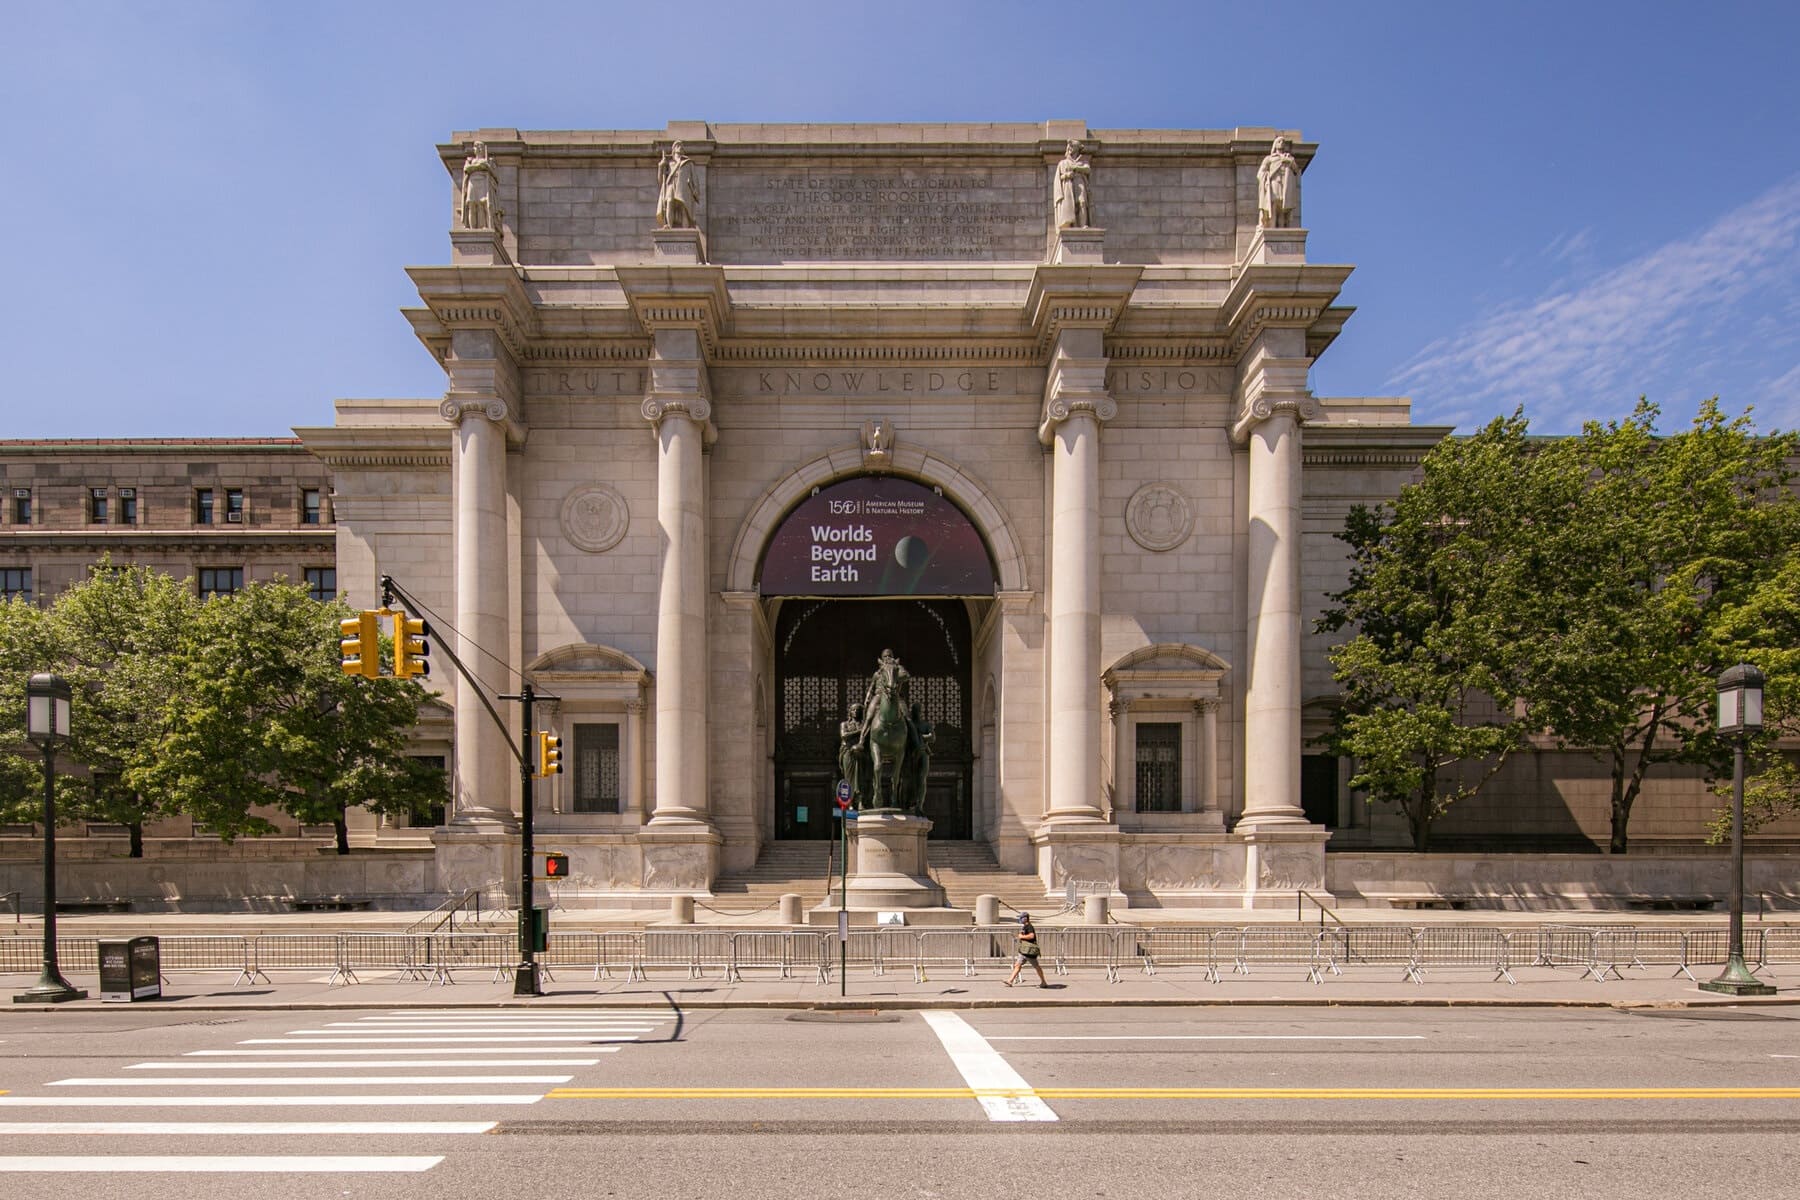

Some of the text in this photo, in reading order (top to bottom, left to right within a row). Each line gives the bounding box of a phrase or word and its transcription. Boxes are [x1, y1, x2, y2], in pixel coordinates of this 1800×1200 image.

[766, 179, 803, 189] STATE
[808, 179, 825, 189] OF
[862, 179, 894, 189] YORK
[793, 191, 961, 202] THEODORE ROOSEVELT
[785, 216, 806, 225] AND
[759, 373, 1000, 391] KNOWLEDGE
[897, 500, 925, 508] MUSEUM
[811, 525, 873, 542] Worlds
[811, 544, 876, 566] Beyond
[811, 565, 859, 582] Earth
